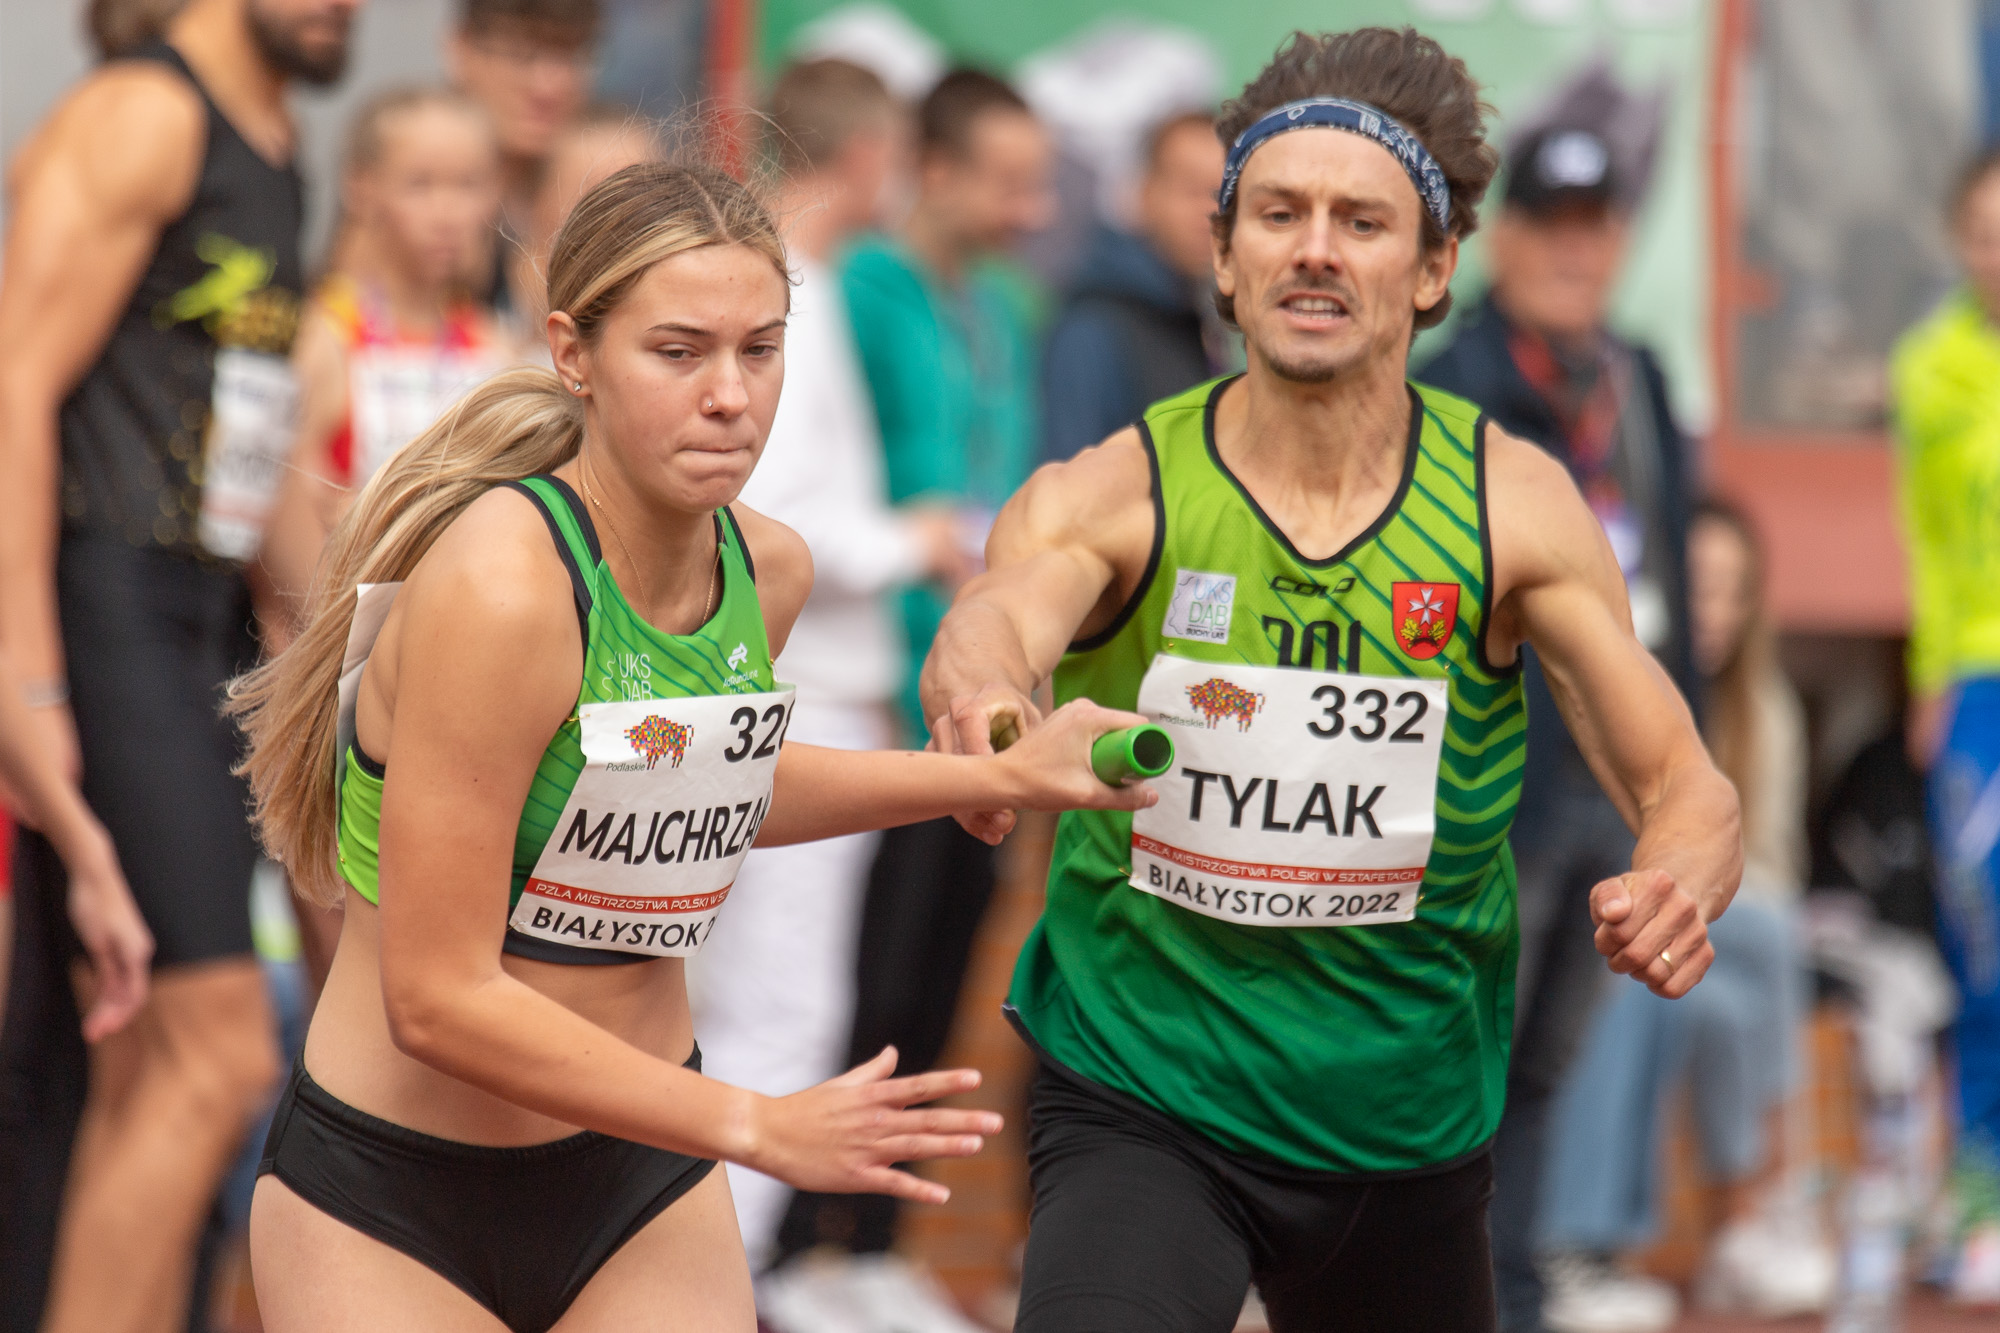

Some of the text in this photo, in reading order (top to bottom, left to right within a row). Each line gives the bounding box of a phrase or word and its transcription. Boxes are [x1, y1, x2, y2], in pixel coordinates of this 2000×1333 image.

[1193, 577, 1232, 604] UKS
[618, 653, 651, 679] UKS
[1158, 712, 1205, 729] Podlaskie
[1307, 684, 1429, 744] 332
[605, 761, 646, 773] Podlaskie
[1181, 767, 1387, 840] TYLAK
[1139, 838, 1418, 883] PZLA MISTRZOSTWA POLSKI W SZTAFETACH
[535, 883, 573, 900] PZLA
[575, 891, 669, 911] MISTRZOSTWA
[670, 895, 709, 910] POLSKI
[709, 895, 719, 907] W
[1147, 862, 1401, 918] BIAŁYSTOK 2022
[530, 906, 704, 948] BIAŁYSTOK
